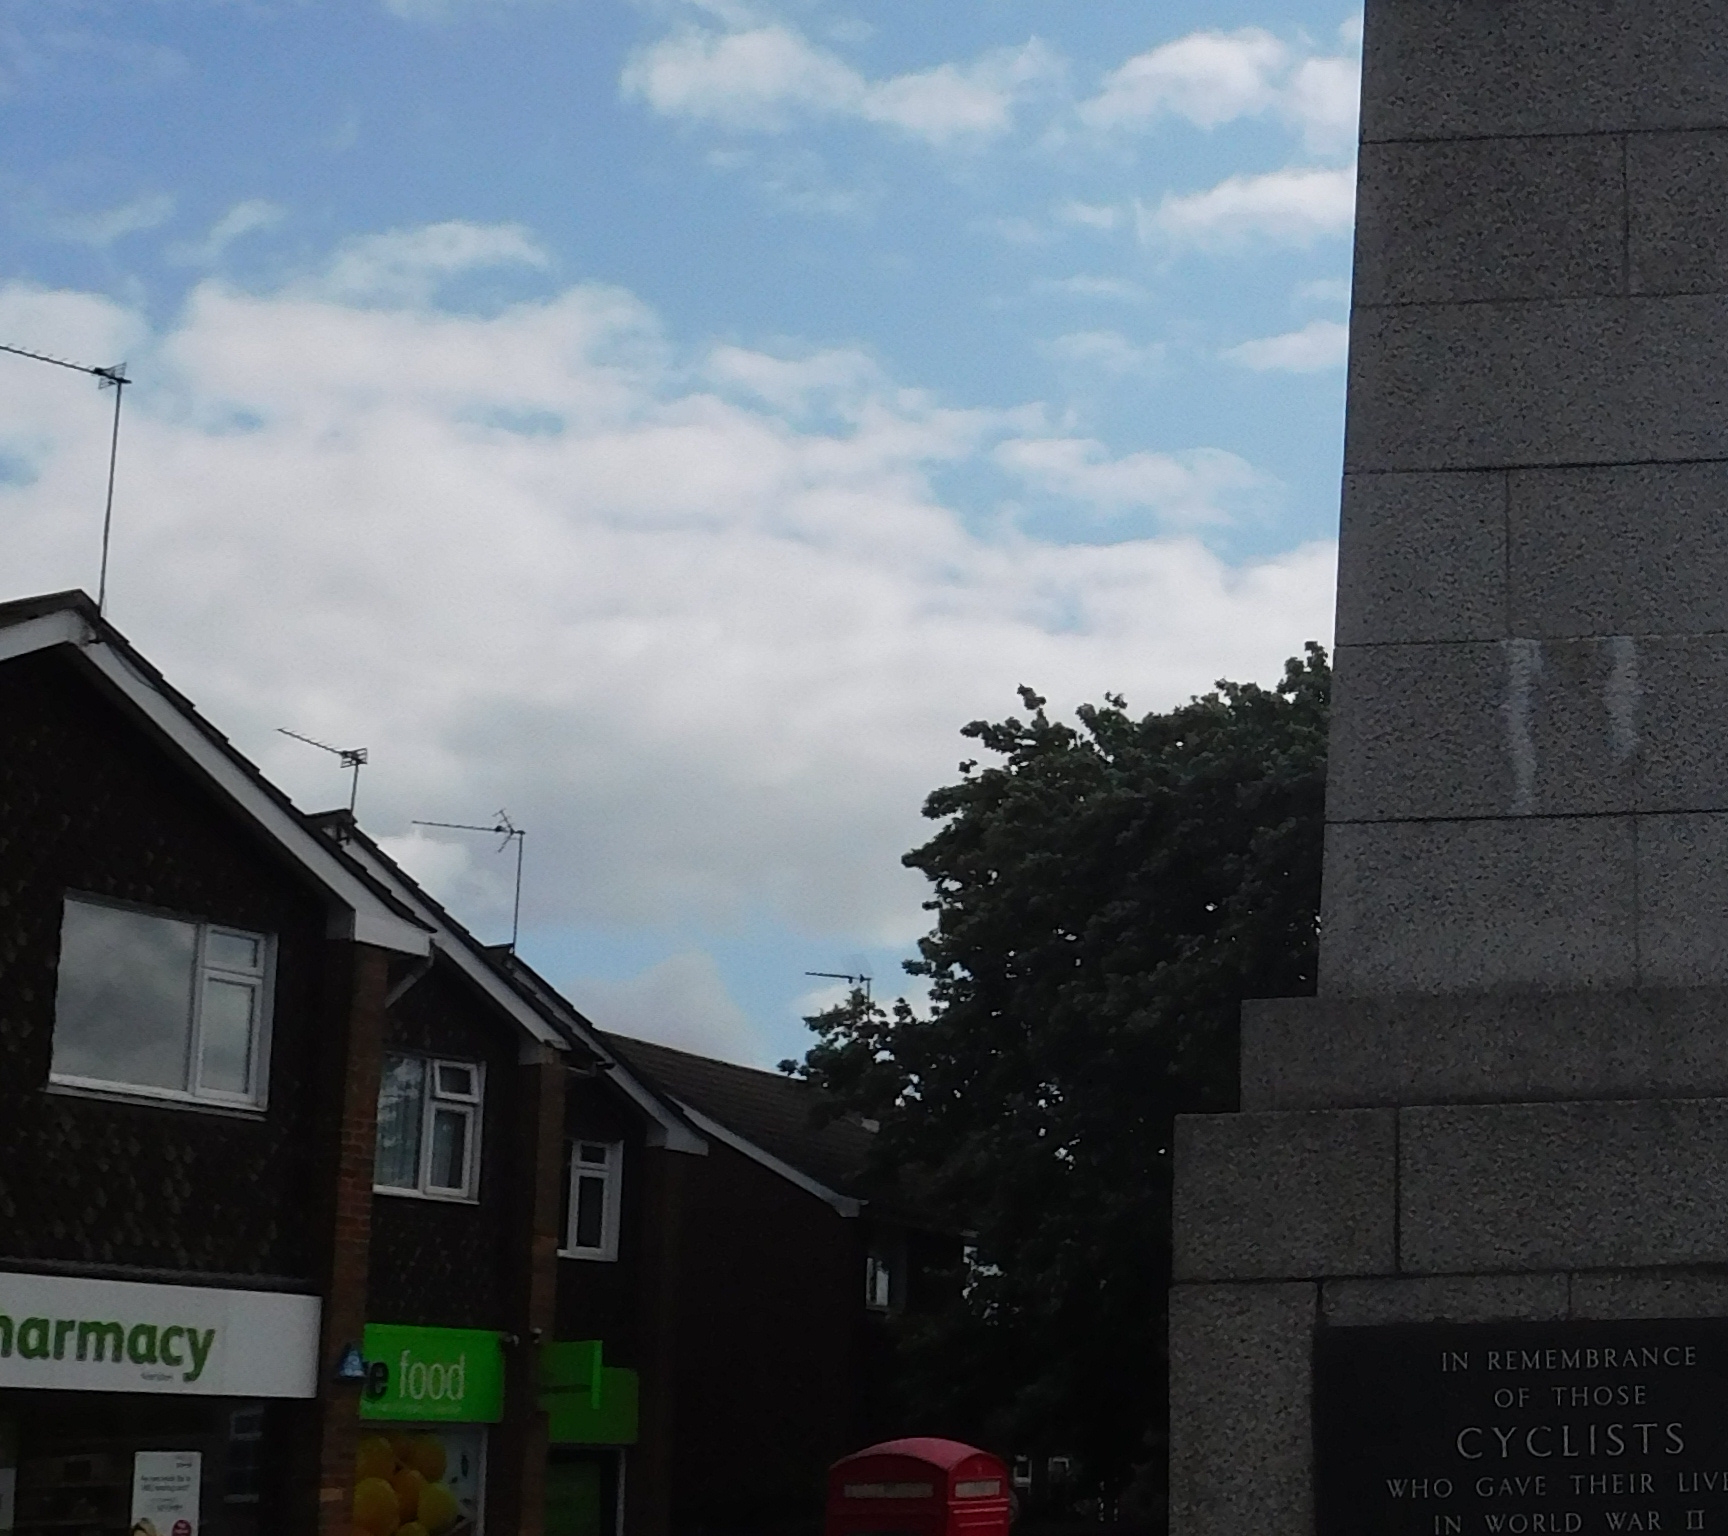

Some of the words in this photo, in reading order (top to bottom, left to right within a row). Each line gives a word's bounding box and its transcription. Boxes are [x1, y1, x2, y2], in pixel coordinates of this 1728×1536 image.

[1442, 1352, 1469, 1372] IN
[1488, 1346, 1697, 1370] REMEMBRANCE
[399, 1349, 465, 1400] food
[1494, 1388, 1530, 1408] OF
[1552, 1385, 1647, 1407] THOSE
[1456, 1422, 1685, 1459] CYCLISTS
[1386, 1478, 1453, 1498] WHO
[1476, 1476, 1546, 1497] GAVE
[1570, 1473, 1654, 1495] THEIR
[1435, 1515, 1462, 1535] IN
[1485, 1513, 1582, 1534] WORLD
[1606, 1511, 1661, 1531] WAR
[1686, 1510, 1705, 1530] II
